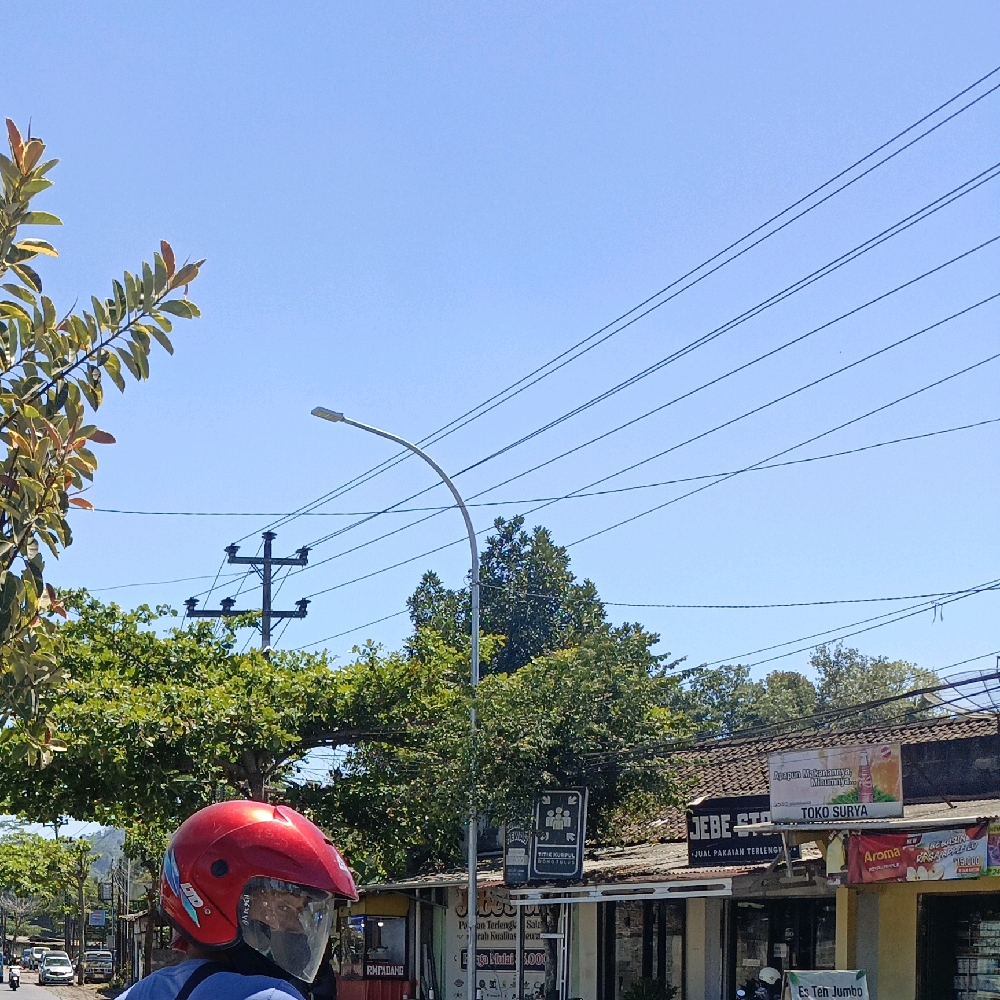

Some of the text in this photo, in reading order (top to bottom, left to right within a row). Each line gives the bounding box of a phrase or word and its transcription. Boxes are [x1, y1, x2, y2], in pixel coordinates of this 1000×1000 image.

[801, 804, 868, 819] TOKO SURYA
[690, 814, 731, 840] JEBE
[694, 845, 784, 858] JUAL PAKAIAN TERLENGK
[865, 847, 900, 863] Aroma
[798, 985, 863, 998] Es Teh Jumbo
